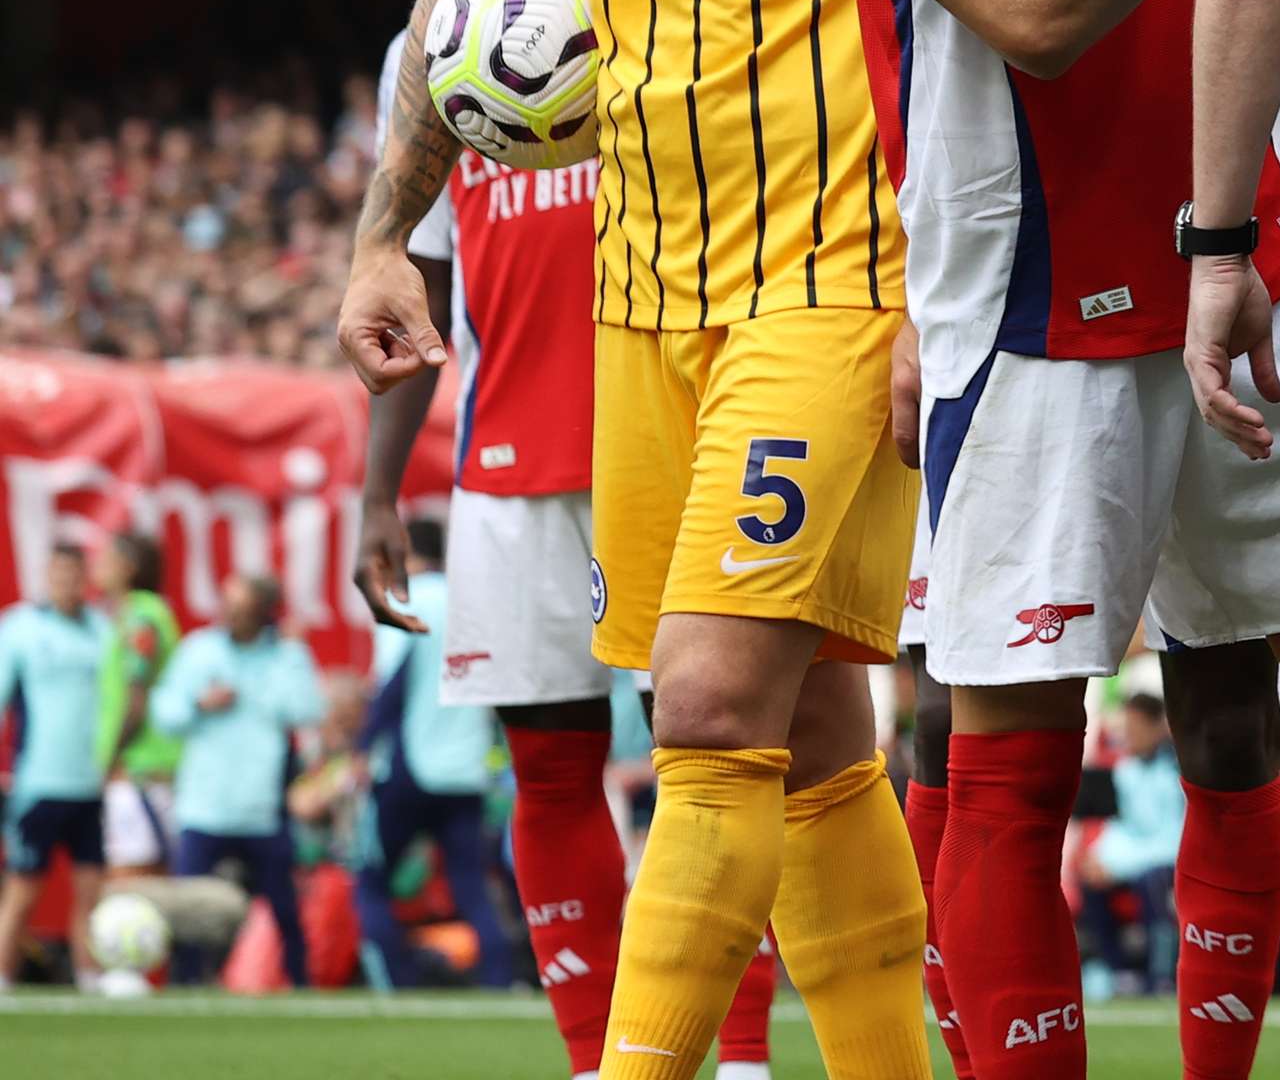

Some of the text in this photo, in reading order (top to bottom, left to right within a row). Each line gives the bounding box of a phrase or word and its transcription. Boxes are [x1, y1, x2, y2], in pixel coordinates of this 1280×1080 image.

[535, 157, 599, 212] BETT
[736, 437, 809, 546] 5
[1184, 922, 1254, 955] AFC
[1005, 1003, 1080, 1049] AFC
